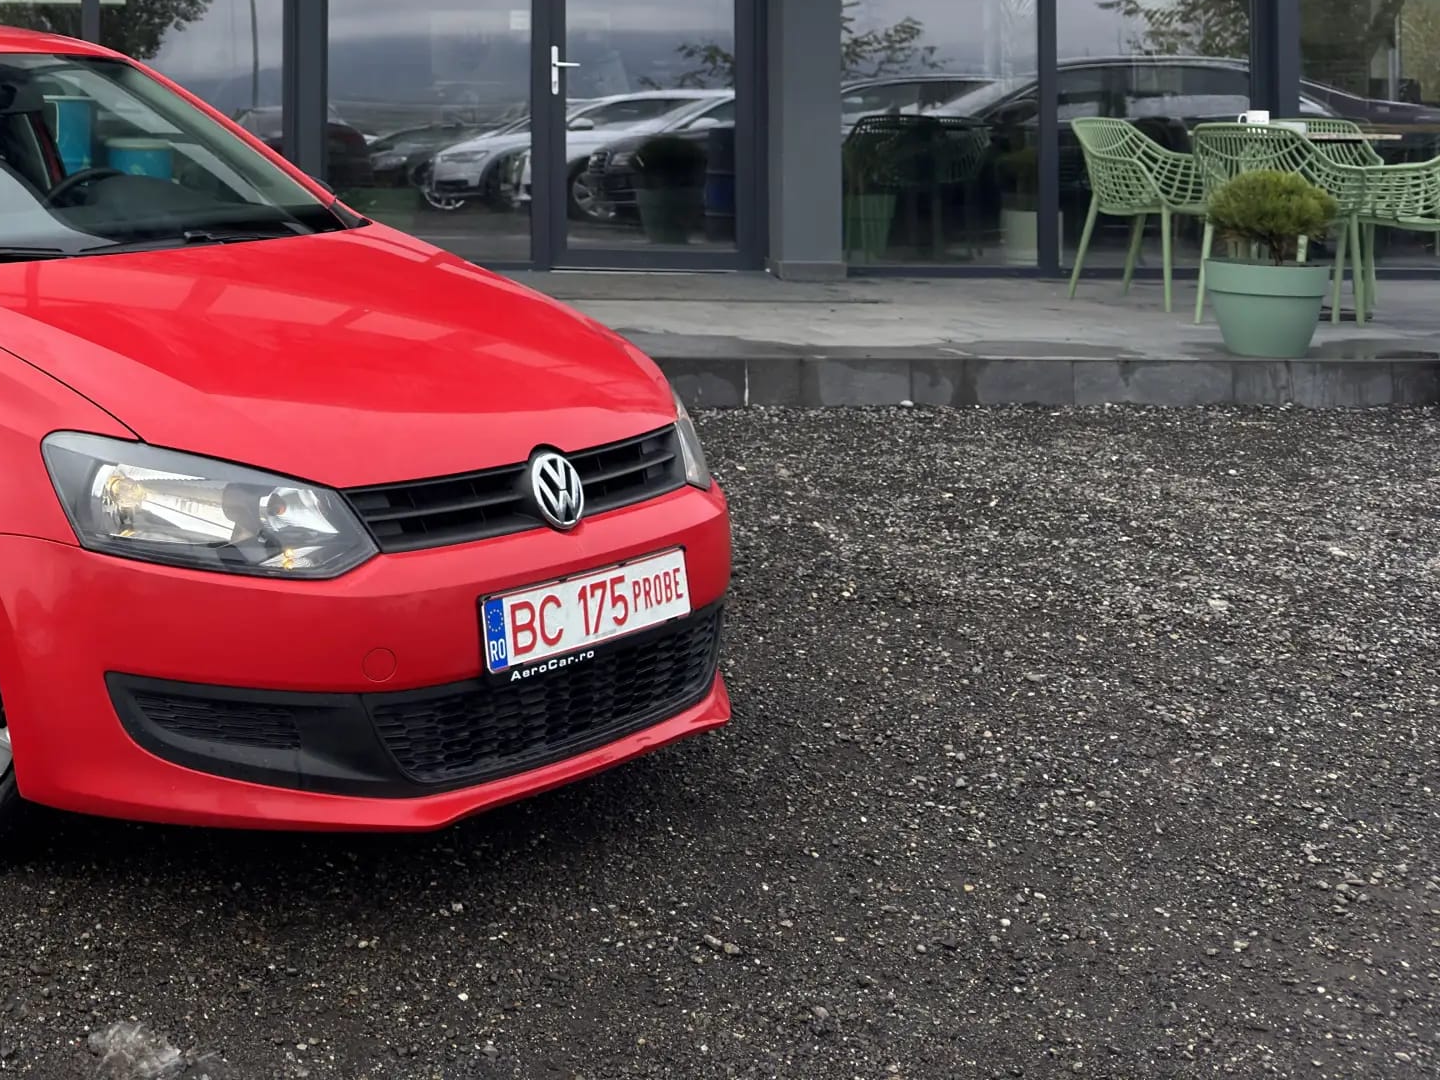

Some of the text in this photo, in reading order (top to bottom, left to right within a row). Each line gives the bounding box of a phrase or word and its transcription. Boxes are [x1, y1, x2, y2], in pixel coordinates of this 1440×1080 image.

[509, 567, 684, 657] BC 175 PROBE
[489, 639, 507, 662] RO
[510, 649, 595, 683] AeroCar.ro
